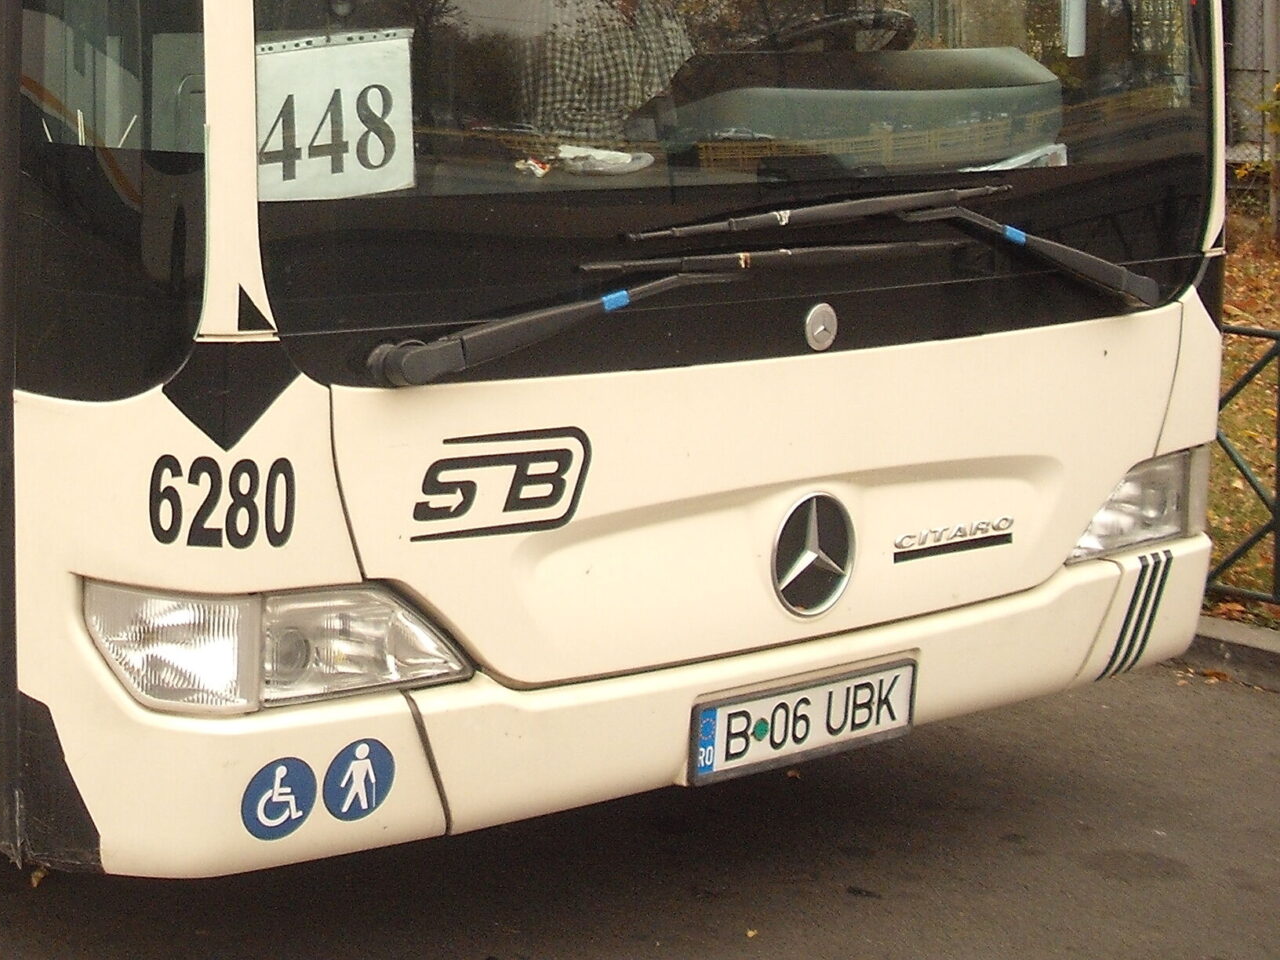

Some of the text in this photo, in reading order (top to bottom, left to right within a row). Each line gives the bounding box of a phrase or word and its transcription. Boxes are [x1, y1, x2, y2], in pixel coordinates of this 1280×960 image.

[259, 83, 396, 181] 448
[148, 454, 295, 549] 6280
[893, 515, 1015, 552] CITARO
[696, 746, 715, 768] RO
[724, 674, 901, 763] B 06 UBK
